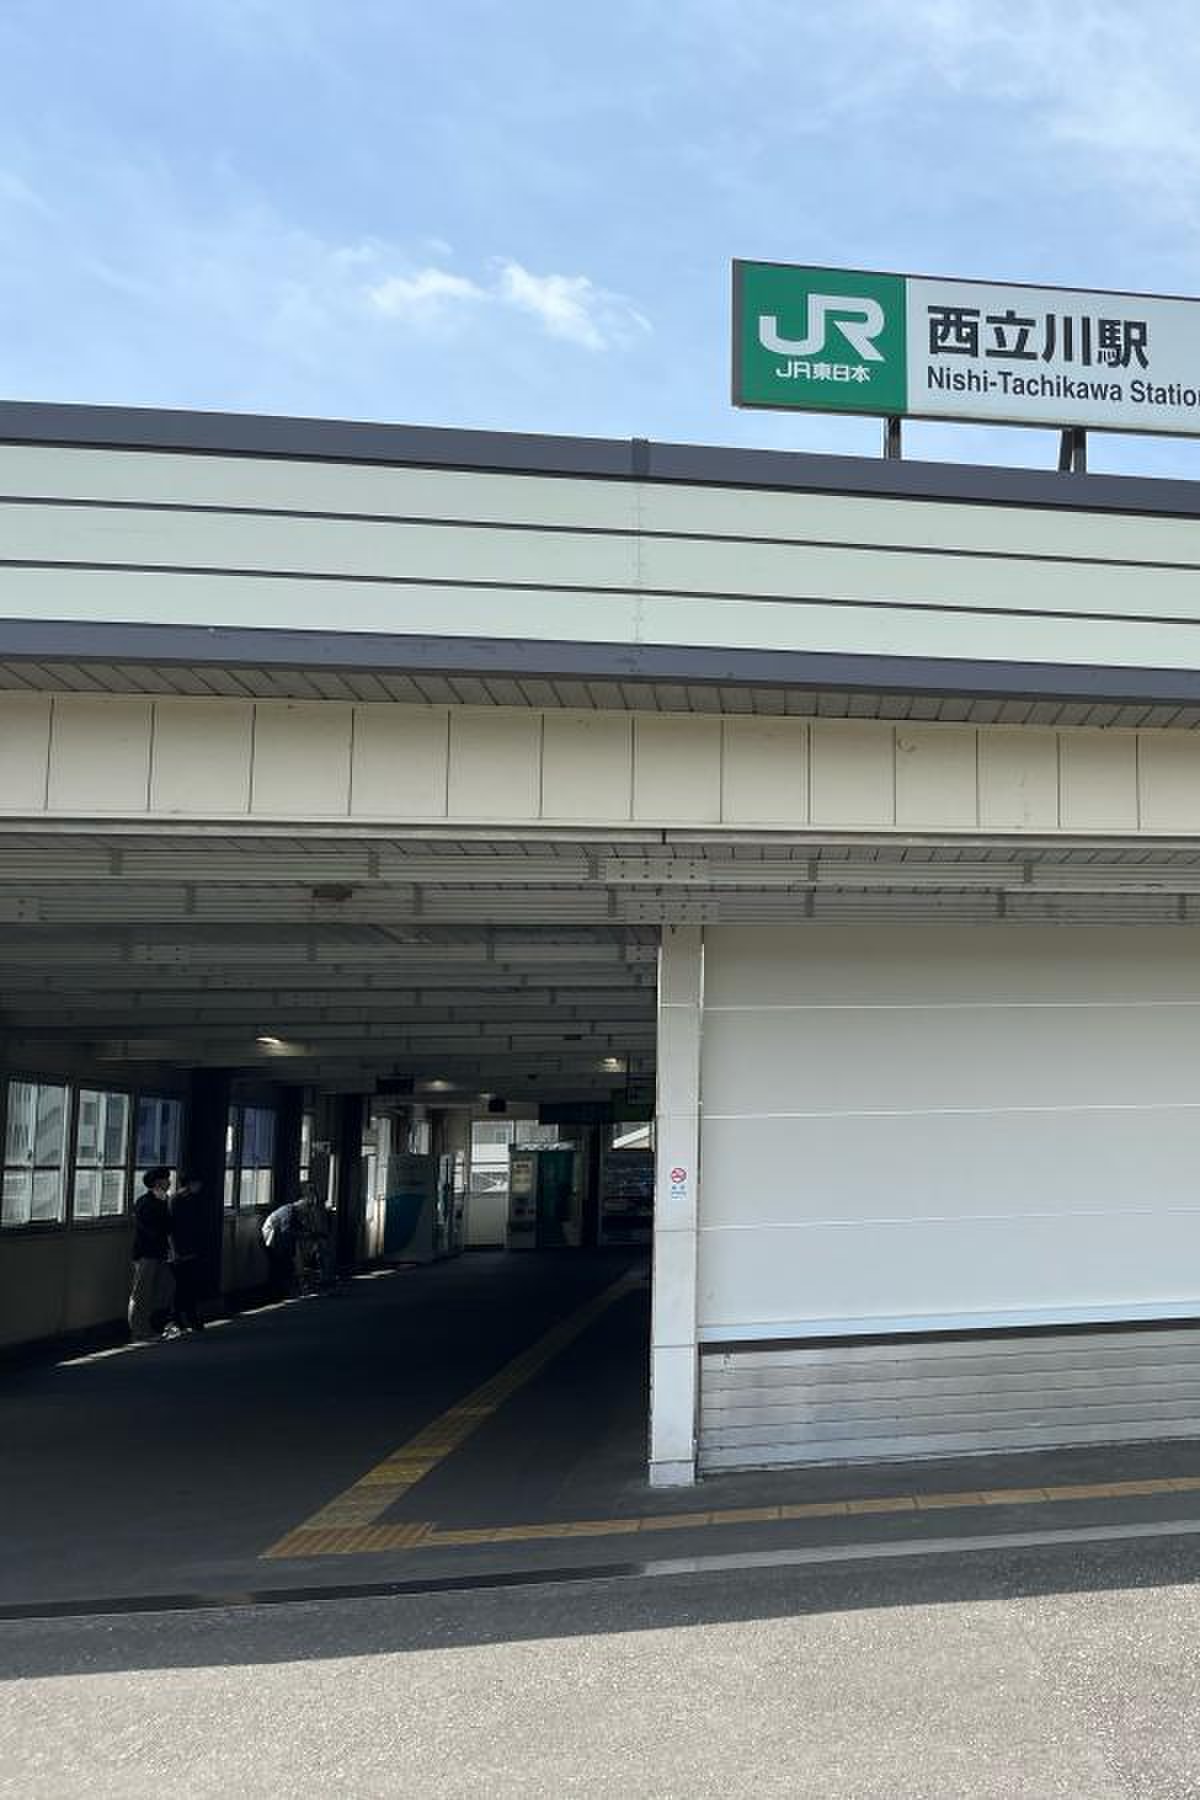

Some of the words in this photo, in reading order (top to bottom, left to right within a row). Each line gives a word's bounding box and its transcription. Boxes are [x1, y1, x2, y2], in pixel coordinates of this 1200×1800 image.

[927, 304, 1149, 369] 西立川駅
[775, 360, 871, 383] JR東日本
[927, 365, 1122, 401] Nishi-Tachikawa
